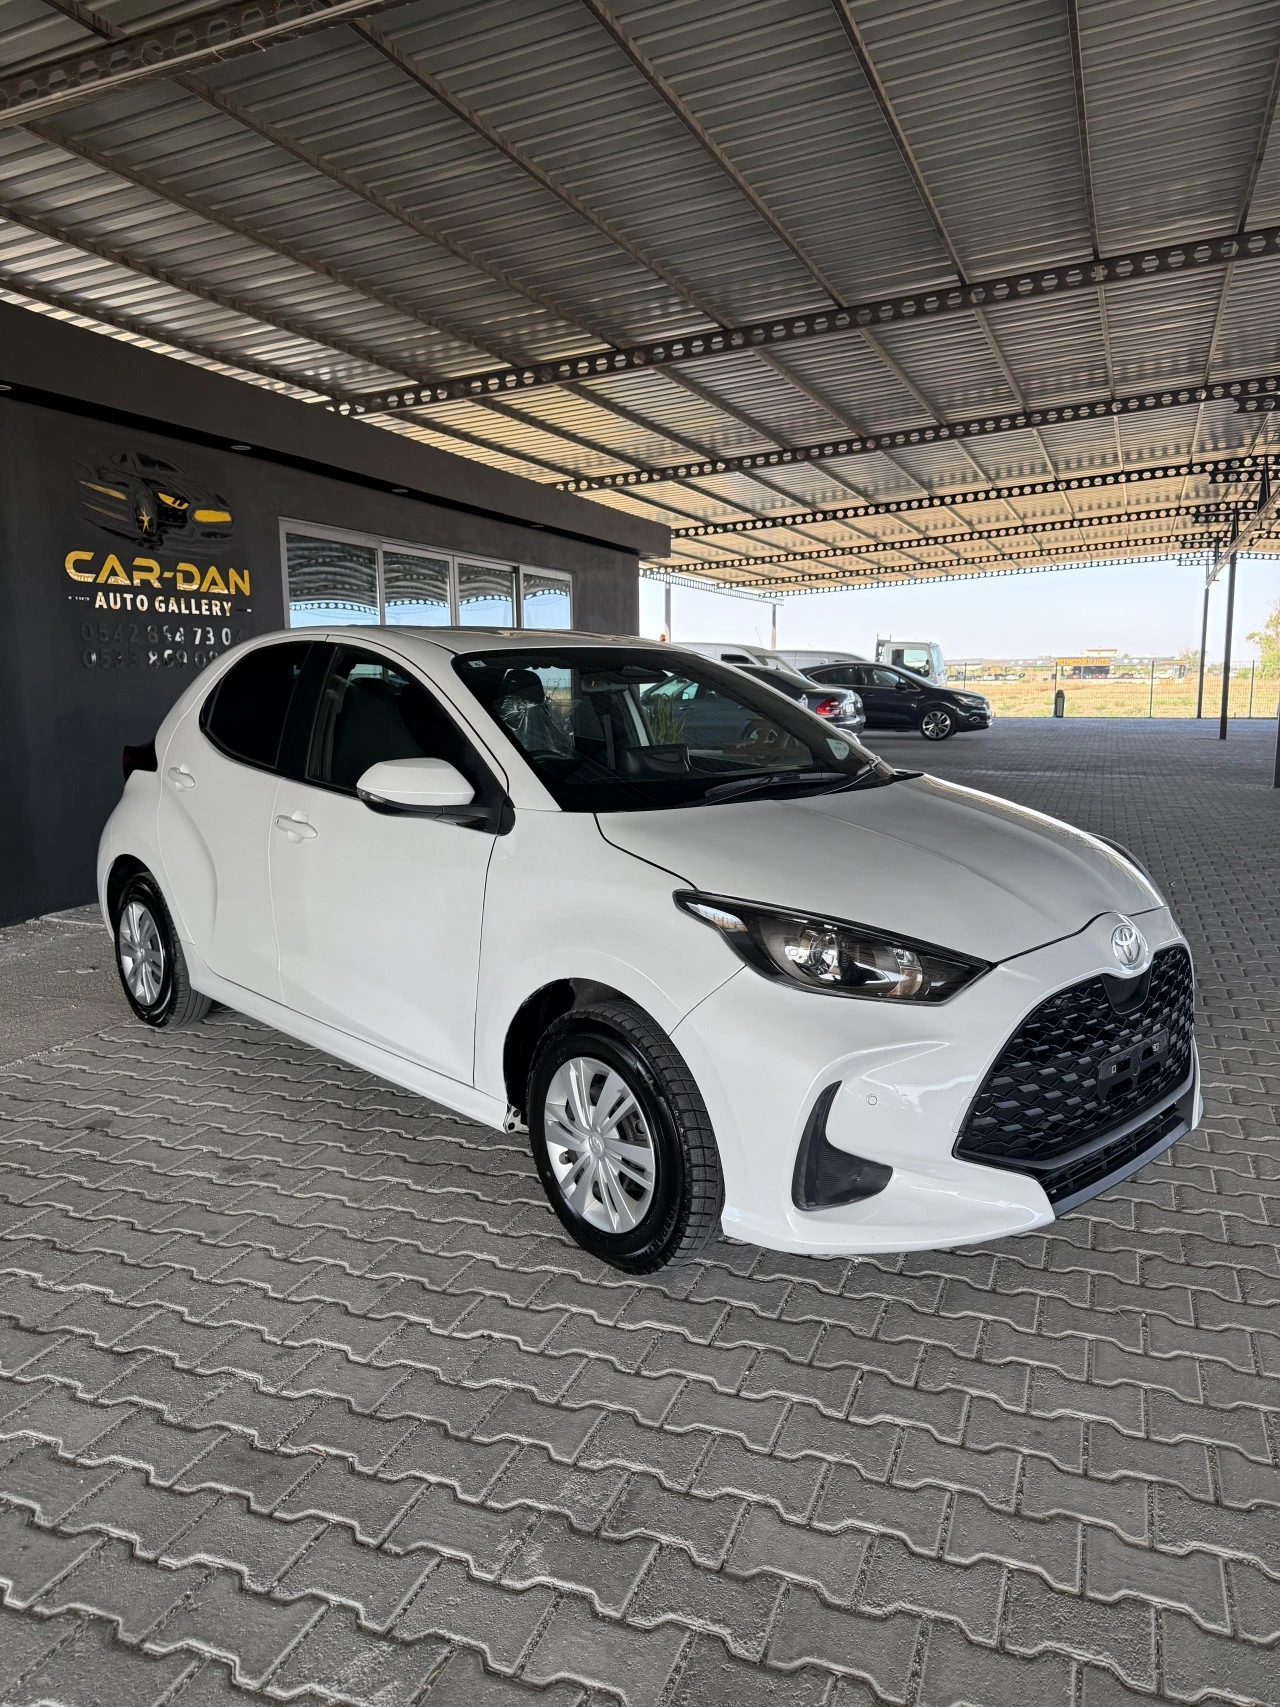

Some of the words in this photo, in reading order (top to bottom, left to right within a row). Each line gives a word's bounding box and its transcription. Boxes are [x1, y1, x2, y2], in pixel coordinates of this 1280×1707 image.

[64, 550, 251, 597] CAR-DAN
[94, 591, 149, 612] AUTO
[154, 596, 232, 617] GALLERY
